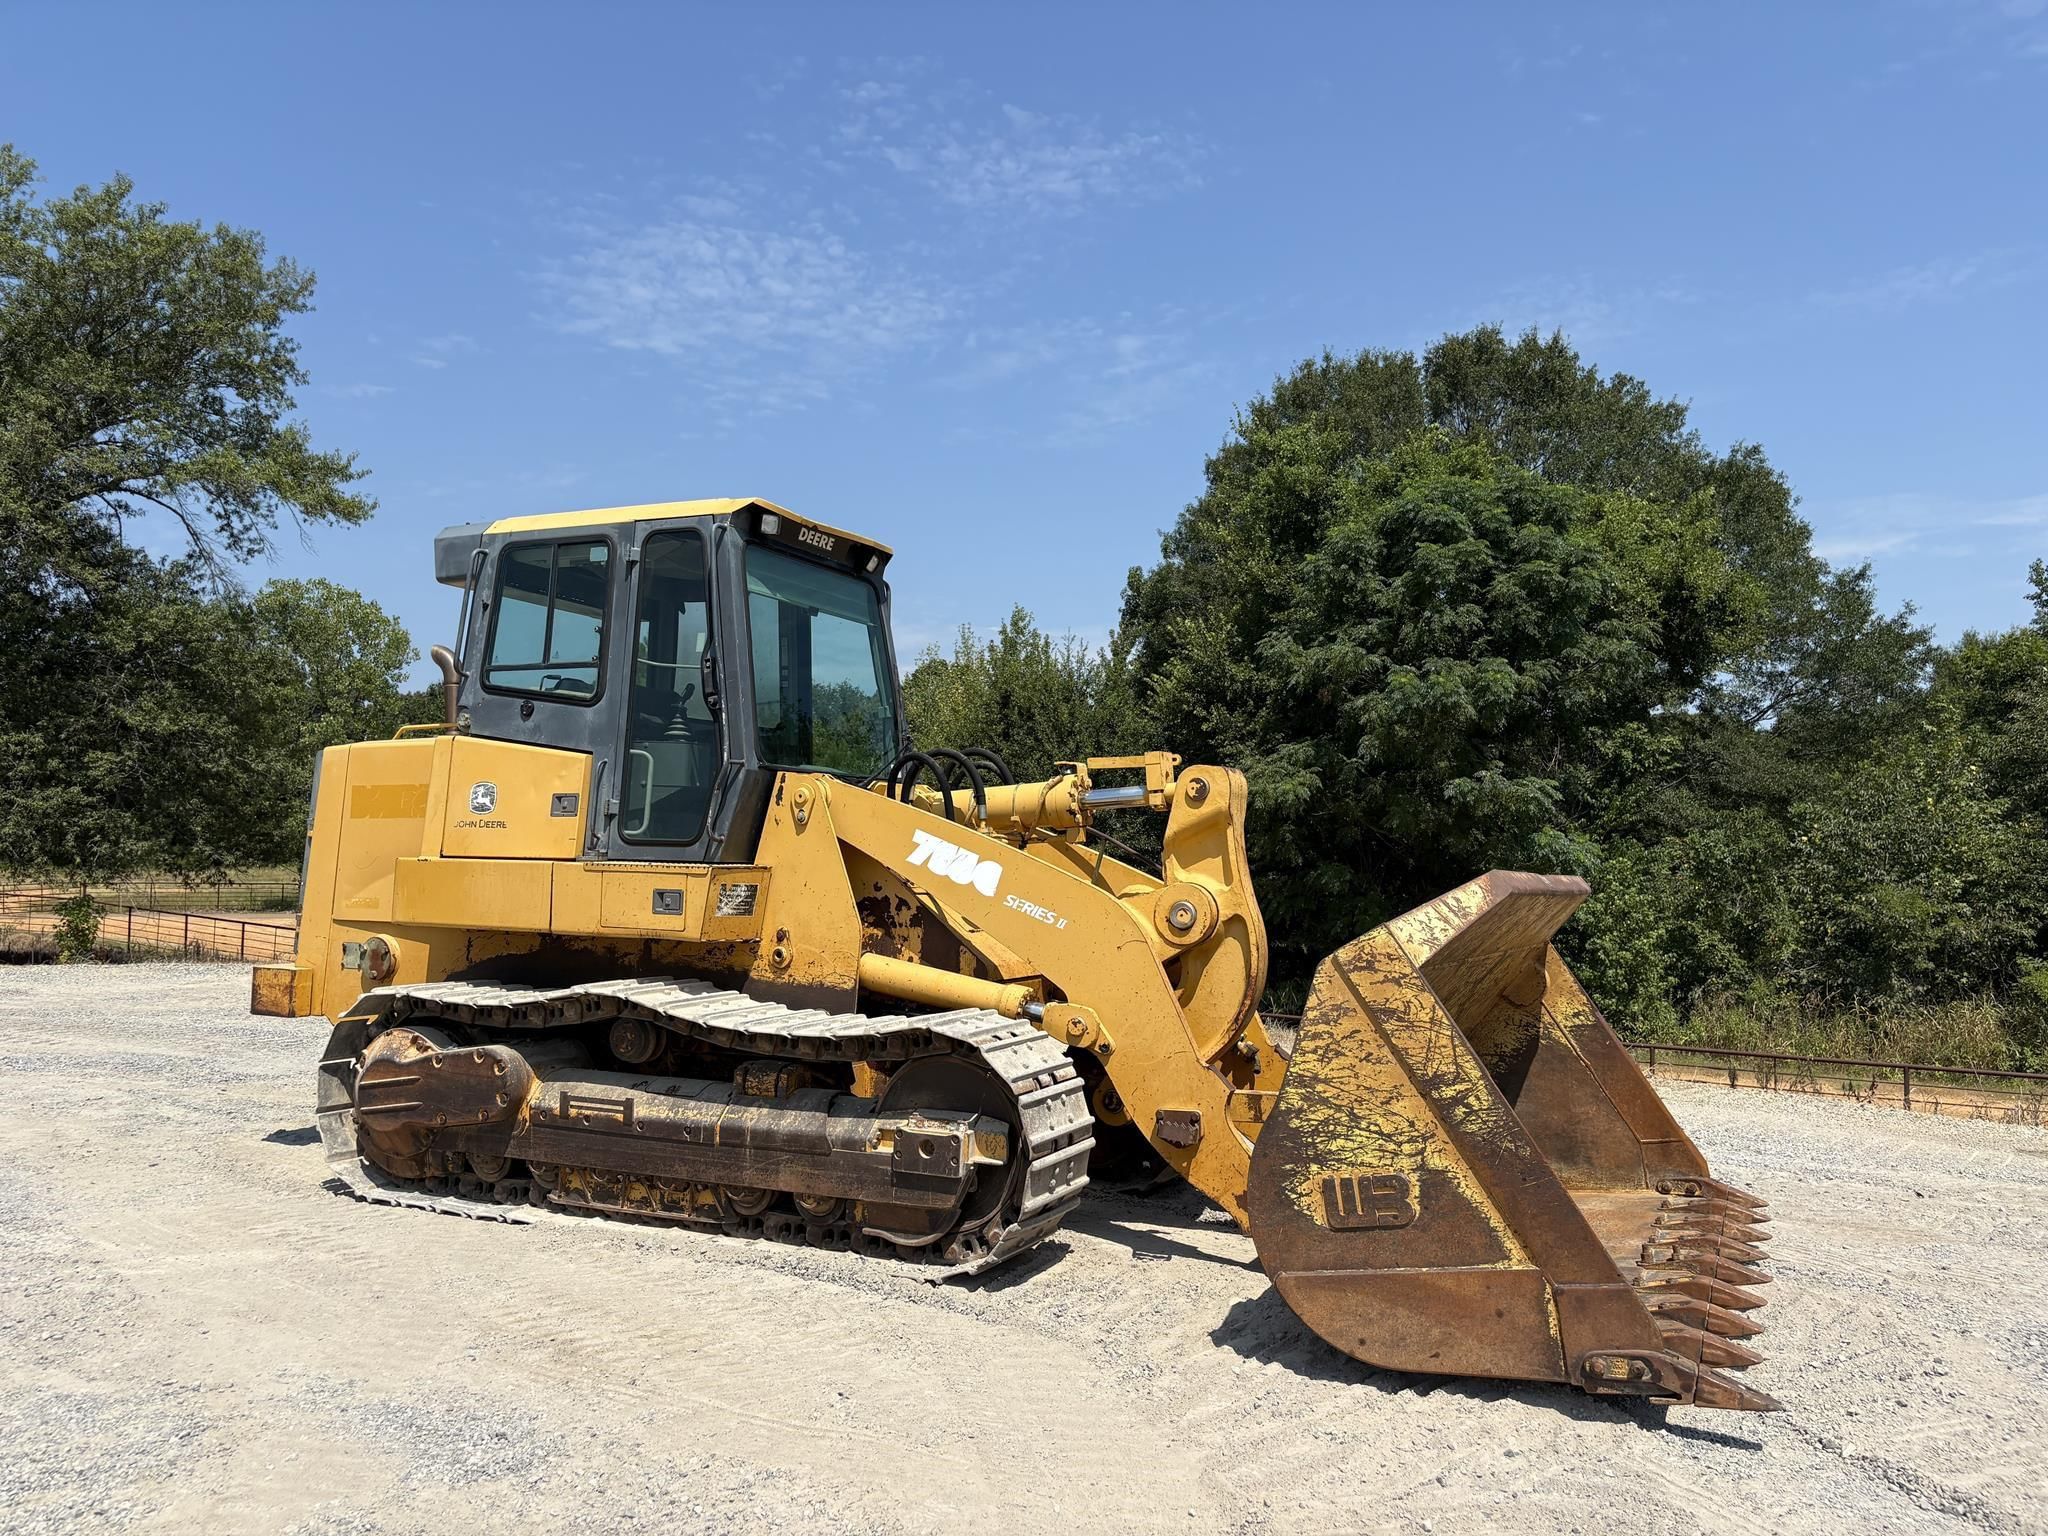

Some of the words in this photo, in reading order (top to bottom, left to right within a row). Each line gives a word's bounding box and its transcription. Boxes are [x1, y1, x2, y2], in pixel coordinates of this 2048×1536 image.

[798, 527, 835, 551] DEERE
[1002, 894, 1057, 924] SERIES
[1056, 917, 1068, 930] II
